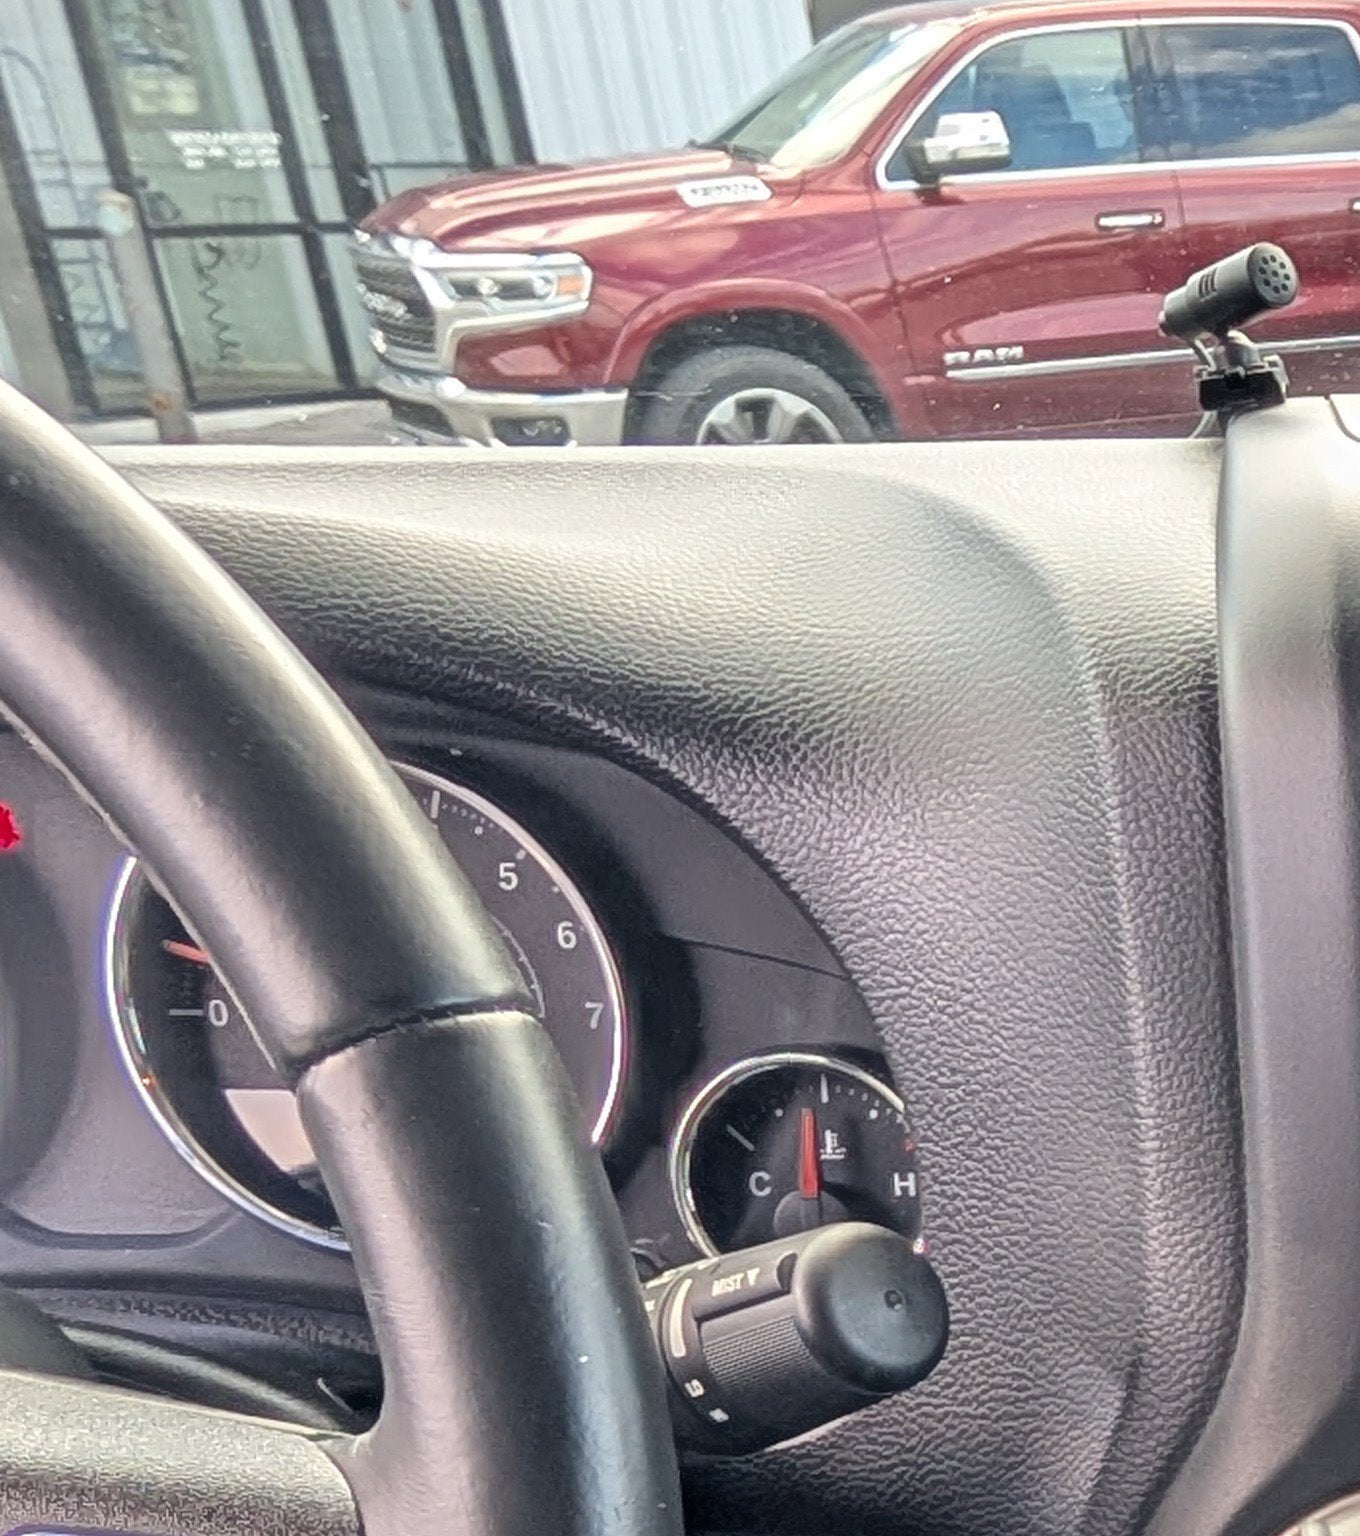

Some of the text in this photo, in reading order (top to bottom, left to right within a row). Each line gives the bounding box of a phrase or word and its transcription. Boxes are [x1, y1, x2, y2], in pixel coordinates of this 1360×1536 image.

[498, 862, 518, 891] 5
[557, 921, 577, 950] 6
[208, 998, 229, 1029] 0
[585, 1001, 604, 1030] 7
[748, 1172, 772, 1196] C
[893, 1173, 917, 1197] H
